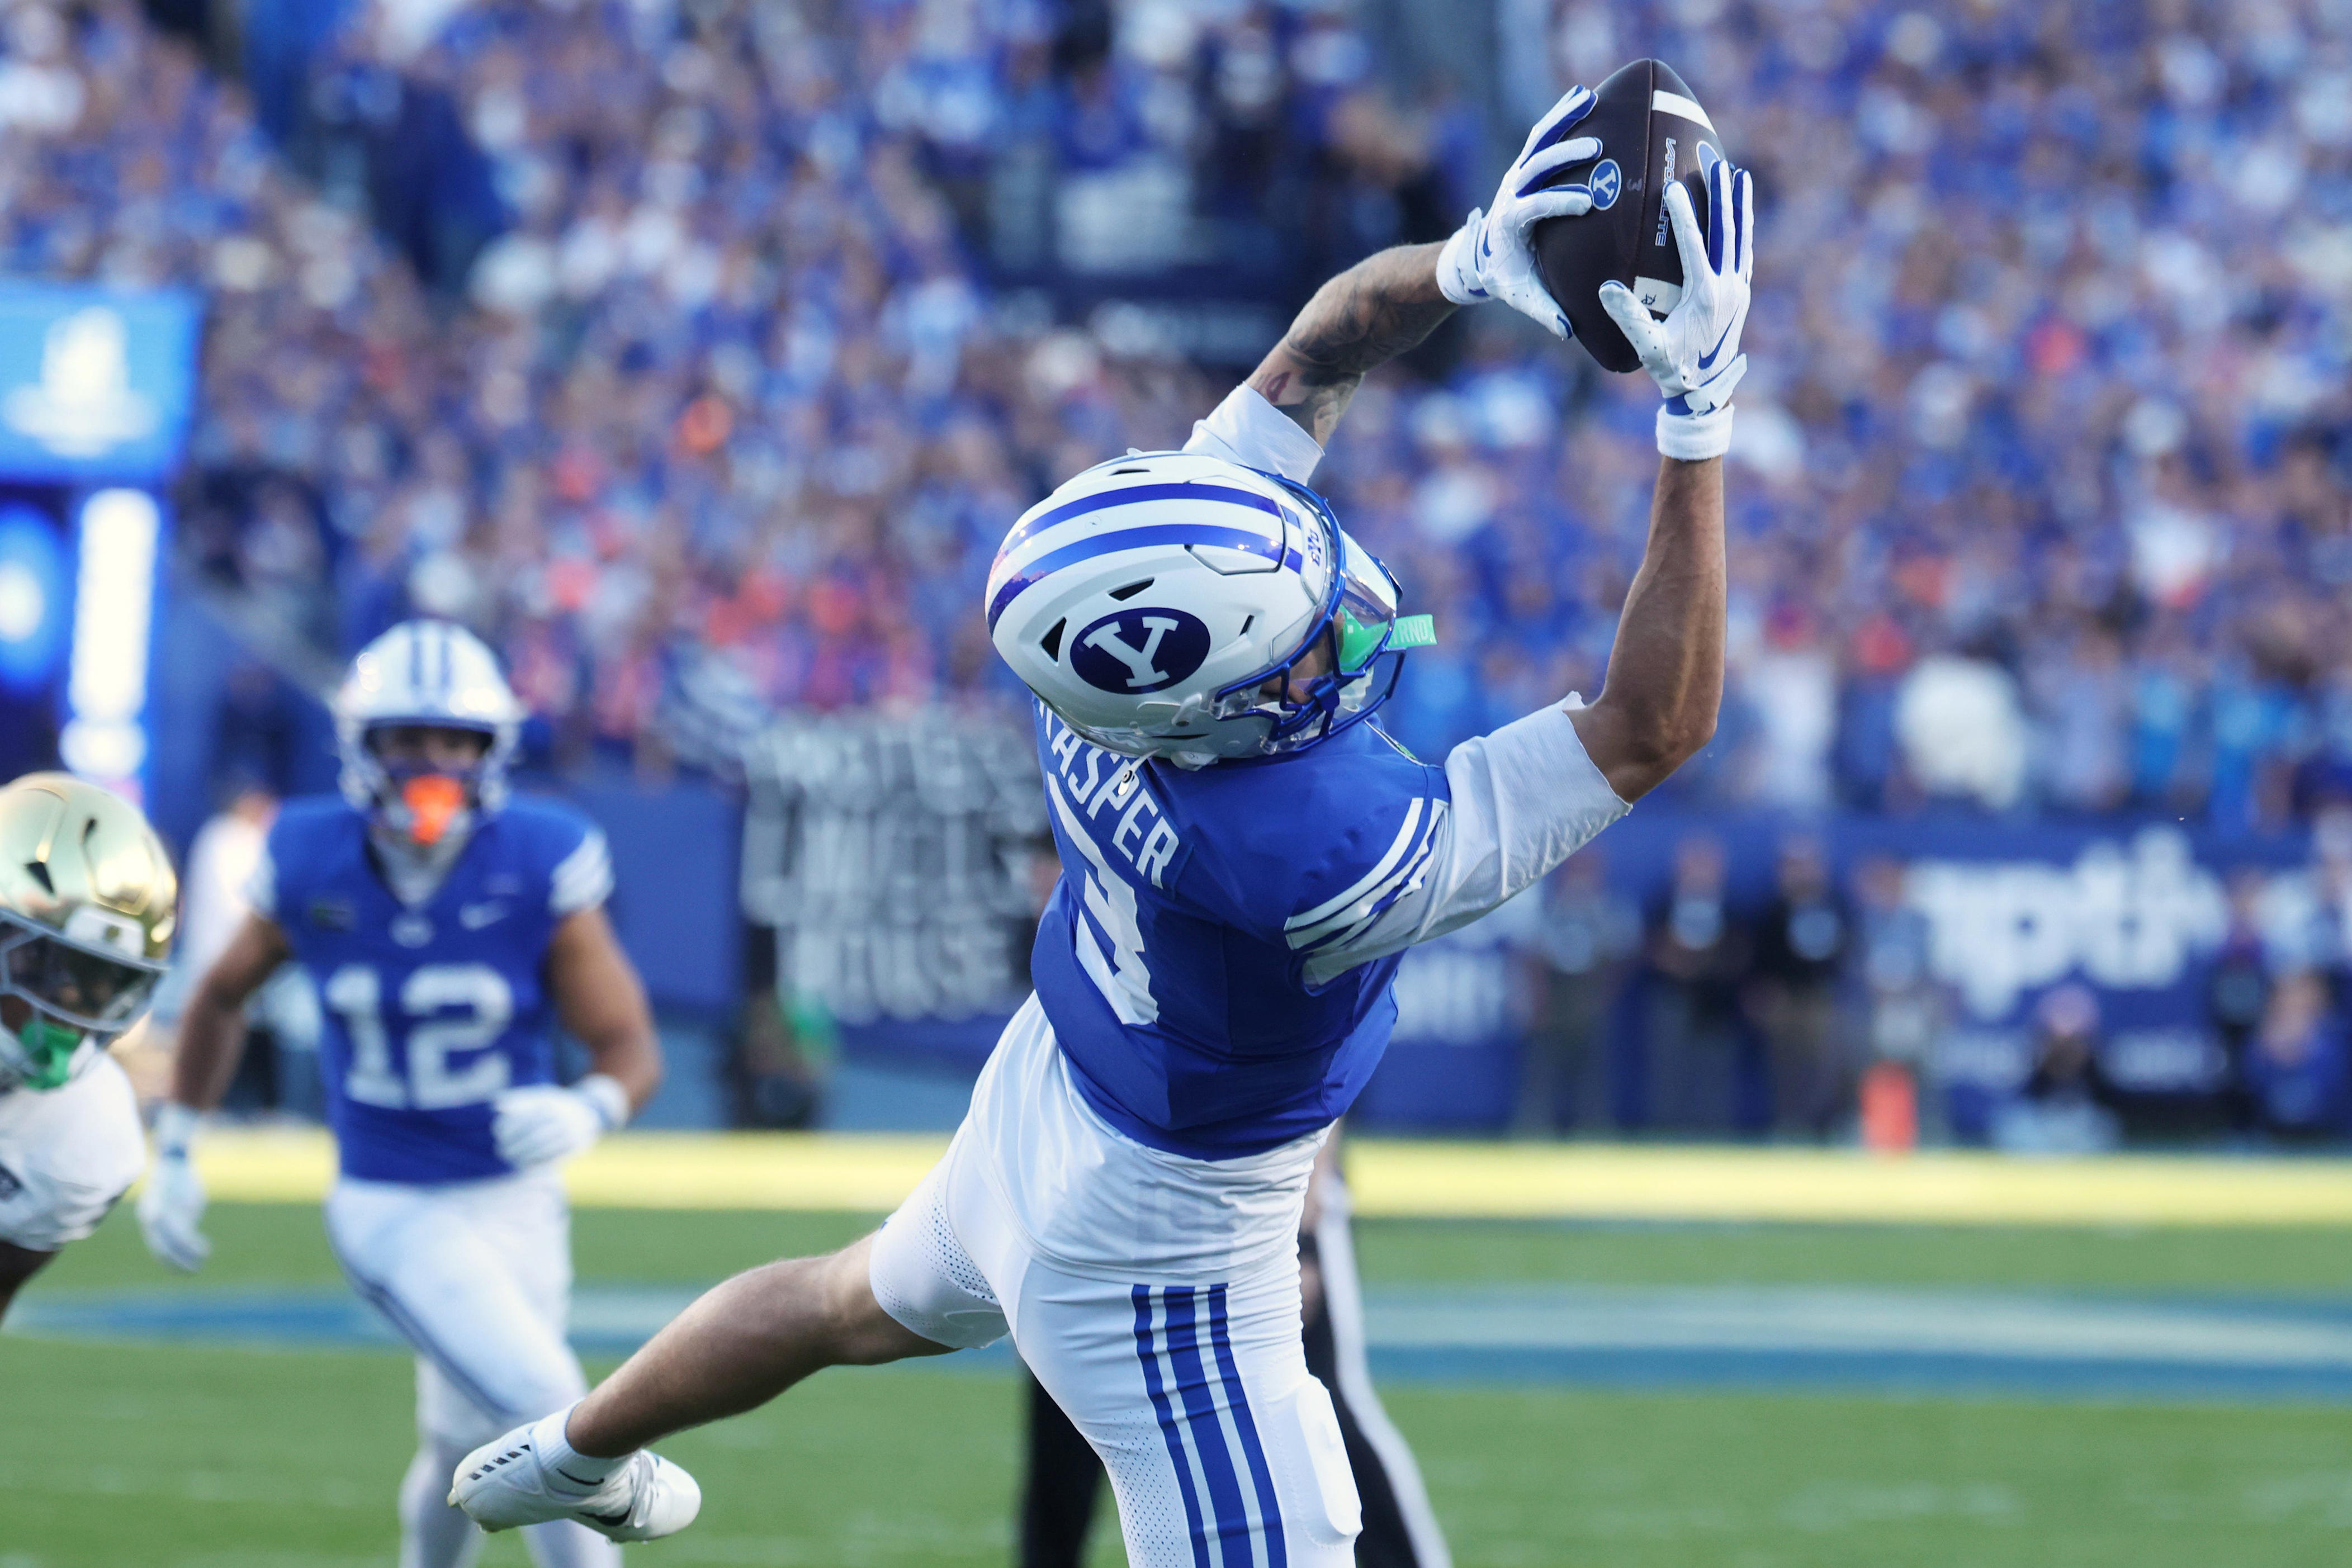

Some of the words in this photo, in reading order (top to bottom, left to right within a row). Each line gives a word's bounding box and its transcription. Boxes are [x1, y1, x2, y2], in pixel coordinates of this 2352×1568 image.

[1593, 168, 1616, 200] Y
[1664, 138, 1677, 184] VAPO
[1655, 196, 1670, 246] LITE
[1308, 528, 1321, 566] BYU
[1082, 617, 1180, 688] Y
[1047, 771, 1159, 1025] 3
[326, 963, 513, 1110] 12
